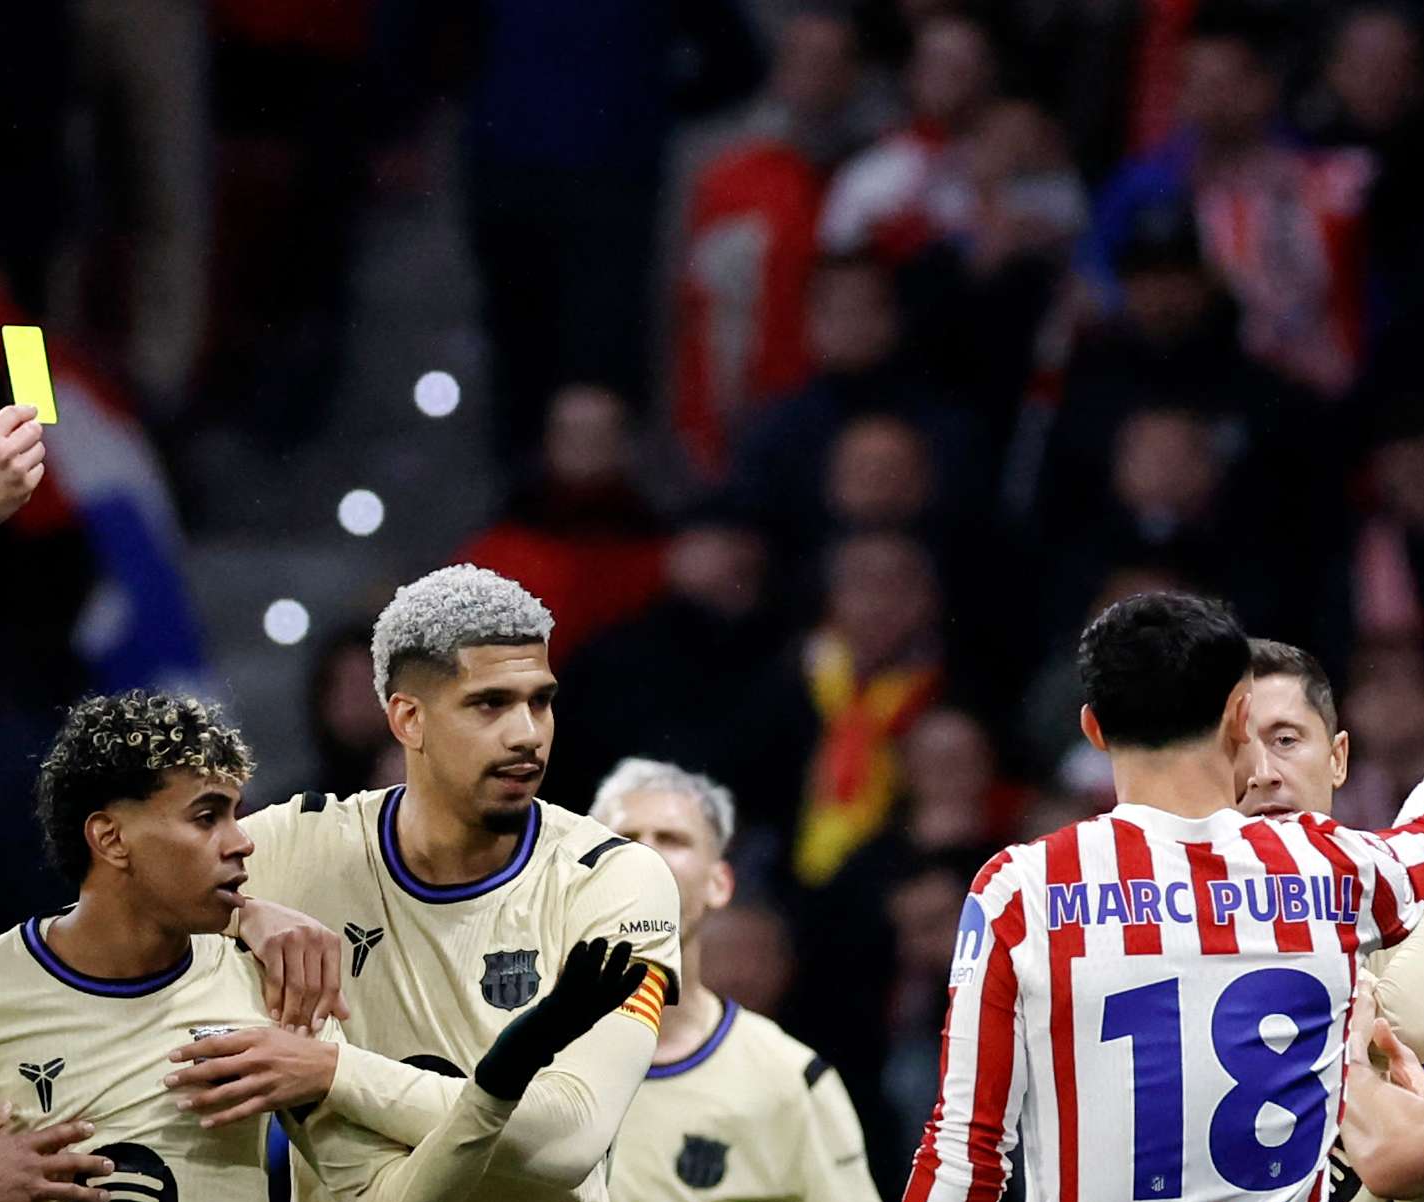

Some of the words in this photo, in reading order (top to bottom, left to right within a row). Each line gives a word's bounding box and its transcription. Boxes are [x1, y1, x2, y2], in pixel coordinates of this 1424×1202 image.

[1047, 880, 1194, 929] MARC
[1208, 874, 1359, 925] PUBILL
[1100, 967, 1333, 1201] 18
